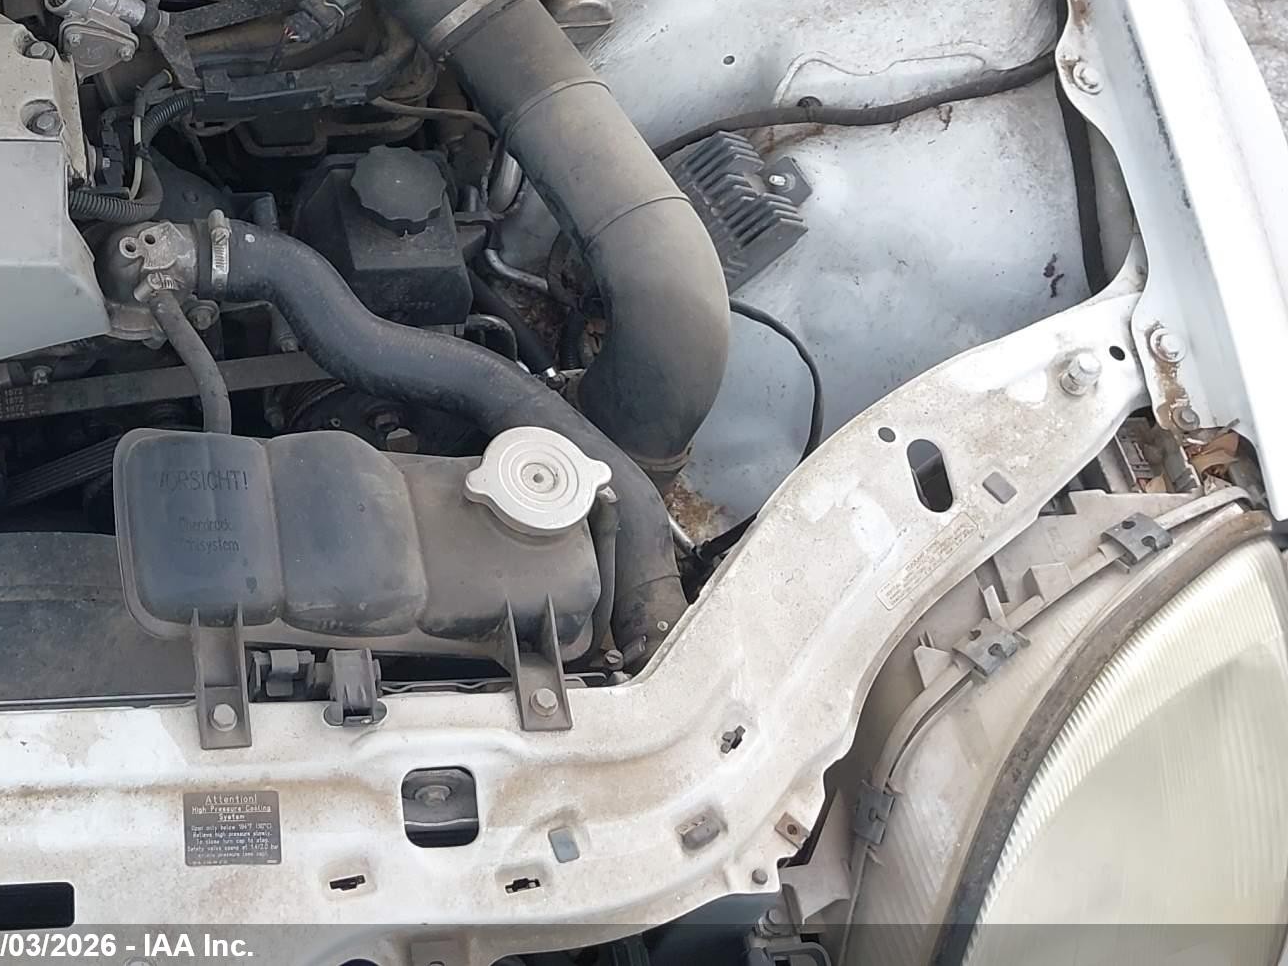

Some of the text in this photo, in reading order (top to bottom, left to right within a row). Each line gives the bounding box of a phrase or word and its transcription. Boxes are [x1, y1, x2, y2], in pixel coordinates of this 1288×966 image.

[205, 793, 258, 805] Attention!
[191, 803, 272, 814] High Pressure Cooling
[218, 813, 246, 822] System
